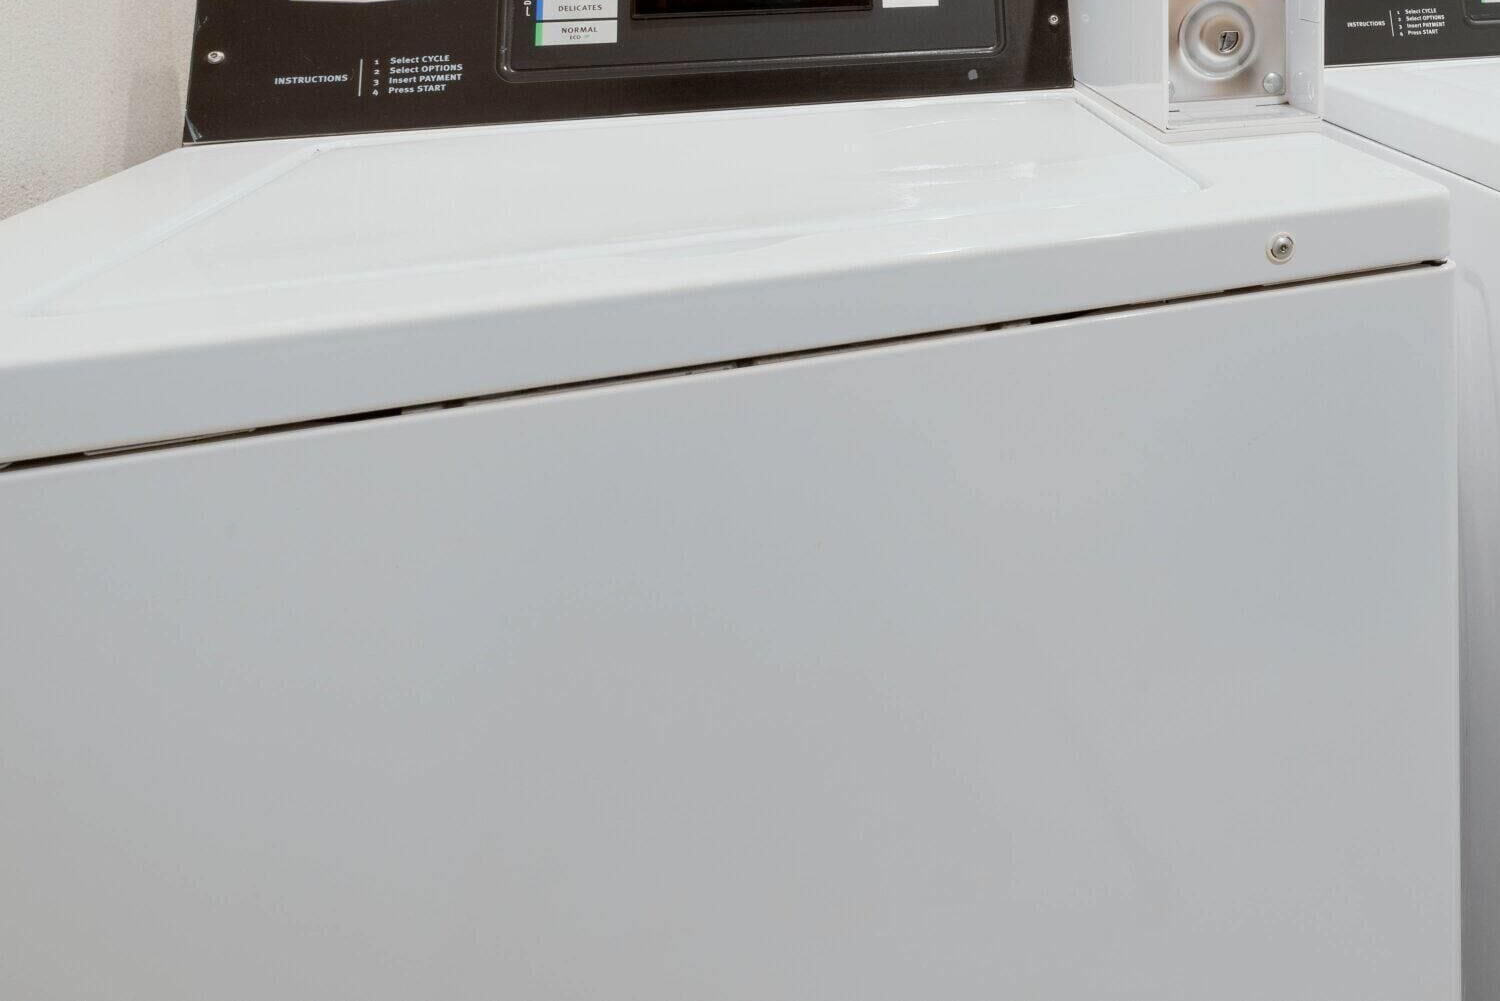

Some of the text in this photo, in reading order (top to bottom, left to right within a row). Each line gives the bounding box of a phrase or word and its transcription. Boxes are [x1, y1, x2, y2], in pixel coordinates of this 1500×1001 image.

[558, 4, 603, 12] DELICATES
[390, 57, 419, 65] Select
[421, 55, 450, 63] CYCLE
[389, 66, 418, 74] Select
[421, 64, 463, 72] OPTIONS
[274, 74, 349, 85] INSTRUCTIONS
[373, 74, 462, 87] 3 Insert PAYMENT
[388, 86, 414, 94] Press
[416, 84, 447, 92] START
